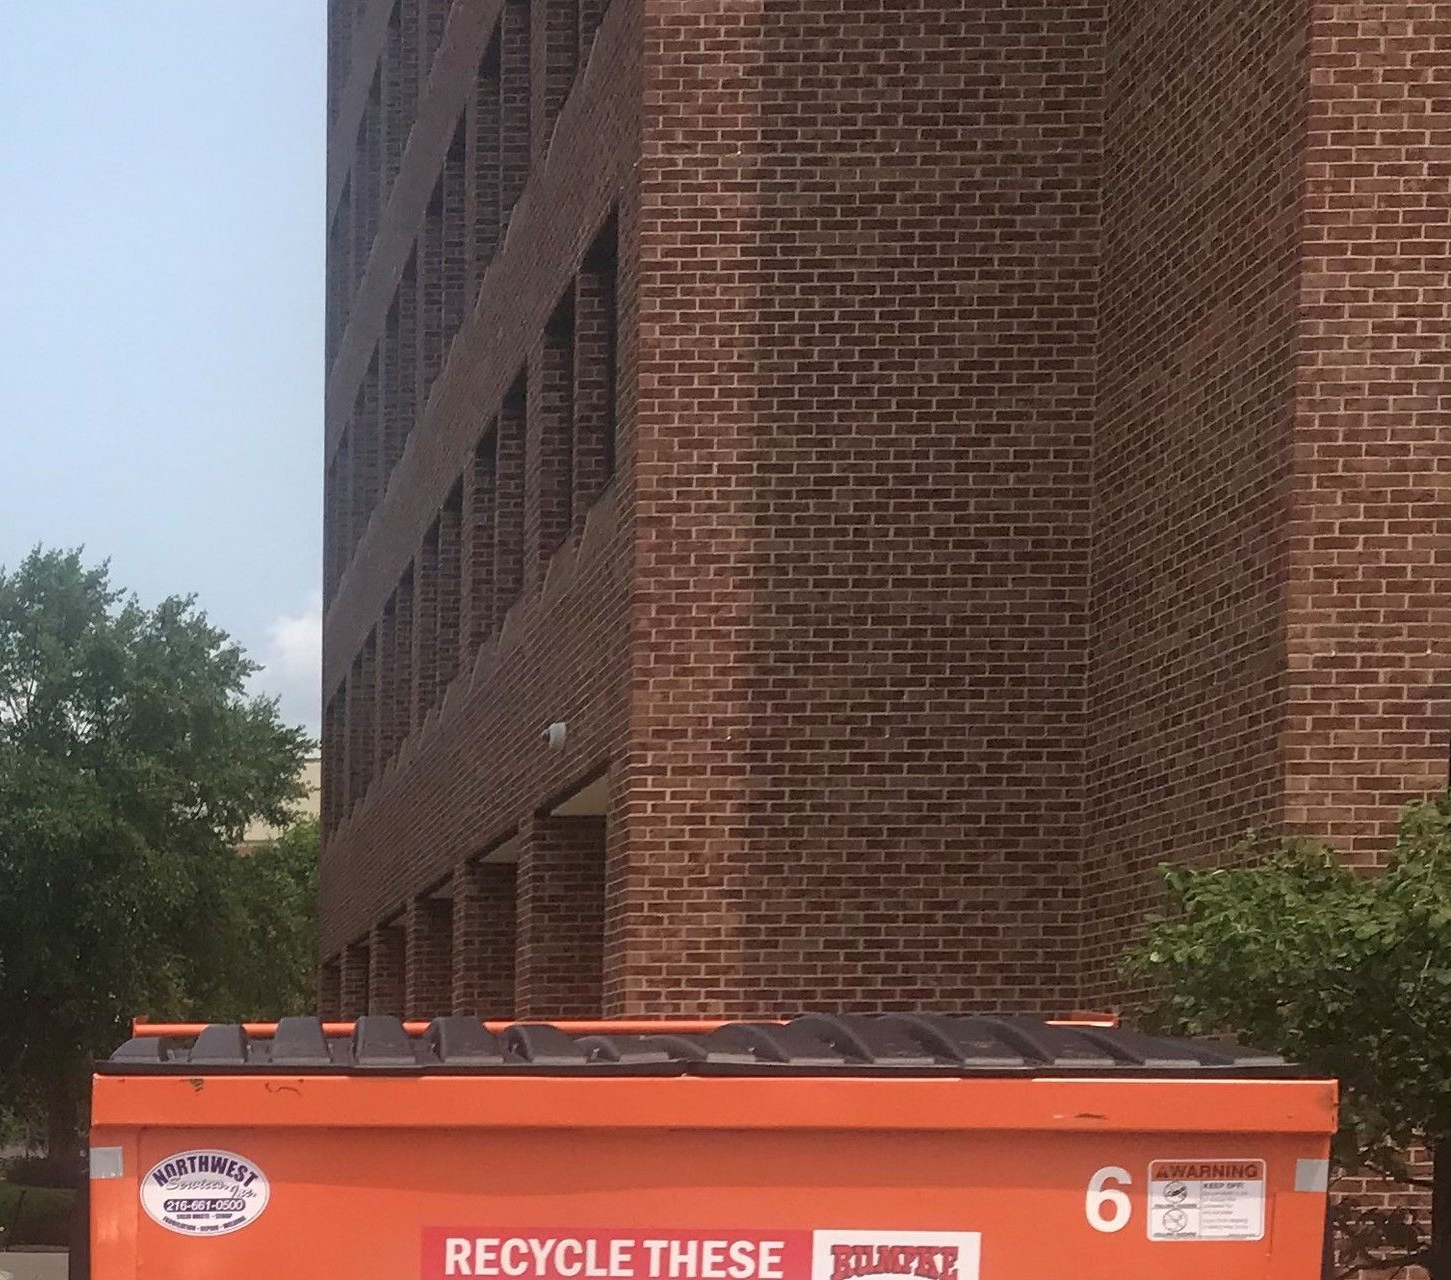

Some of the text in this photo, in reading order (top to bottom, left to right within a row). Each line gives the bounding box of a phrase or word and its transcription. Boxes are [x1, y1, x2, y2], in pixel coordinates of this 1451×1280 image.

[152, 1155, 259, 1187] NORTHWEST
[1169, 1164, 1258, 1178] WARNING
[166, 1200, 243, 1211] 216-661-0500
[1085, 1166, 1132, 1232] 6
[444, 1237, 785, 1279] RECYCLE THESE
